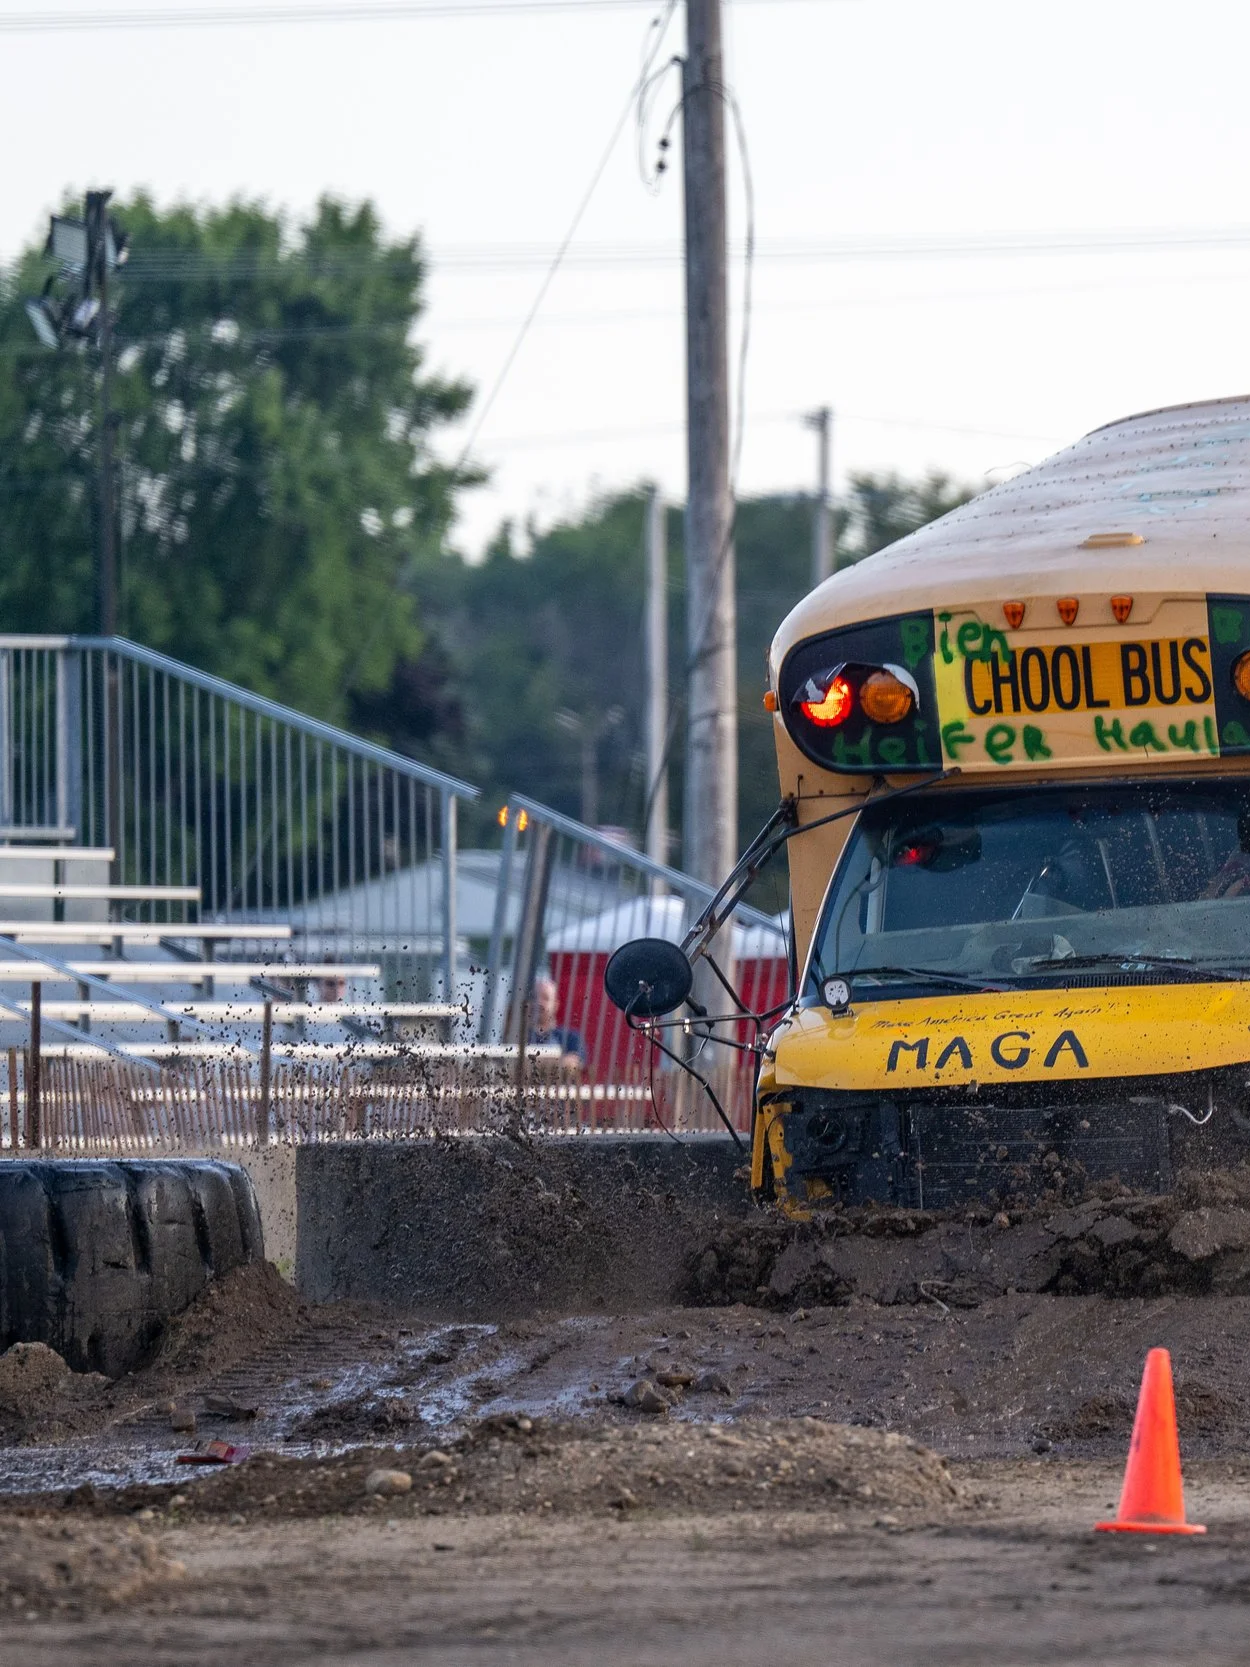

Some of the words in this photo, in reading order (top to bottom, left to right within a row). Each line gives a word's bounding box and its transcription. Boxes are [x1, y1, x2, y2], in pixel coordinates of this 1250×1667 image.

[1120, 639, 1212, 706] BUS
[994, 1010, 1043, 1021] Great
[887, 1029, 1089, 1073] MAGA
